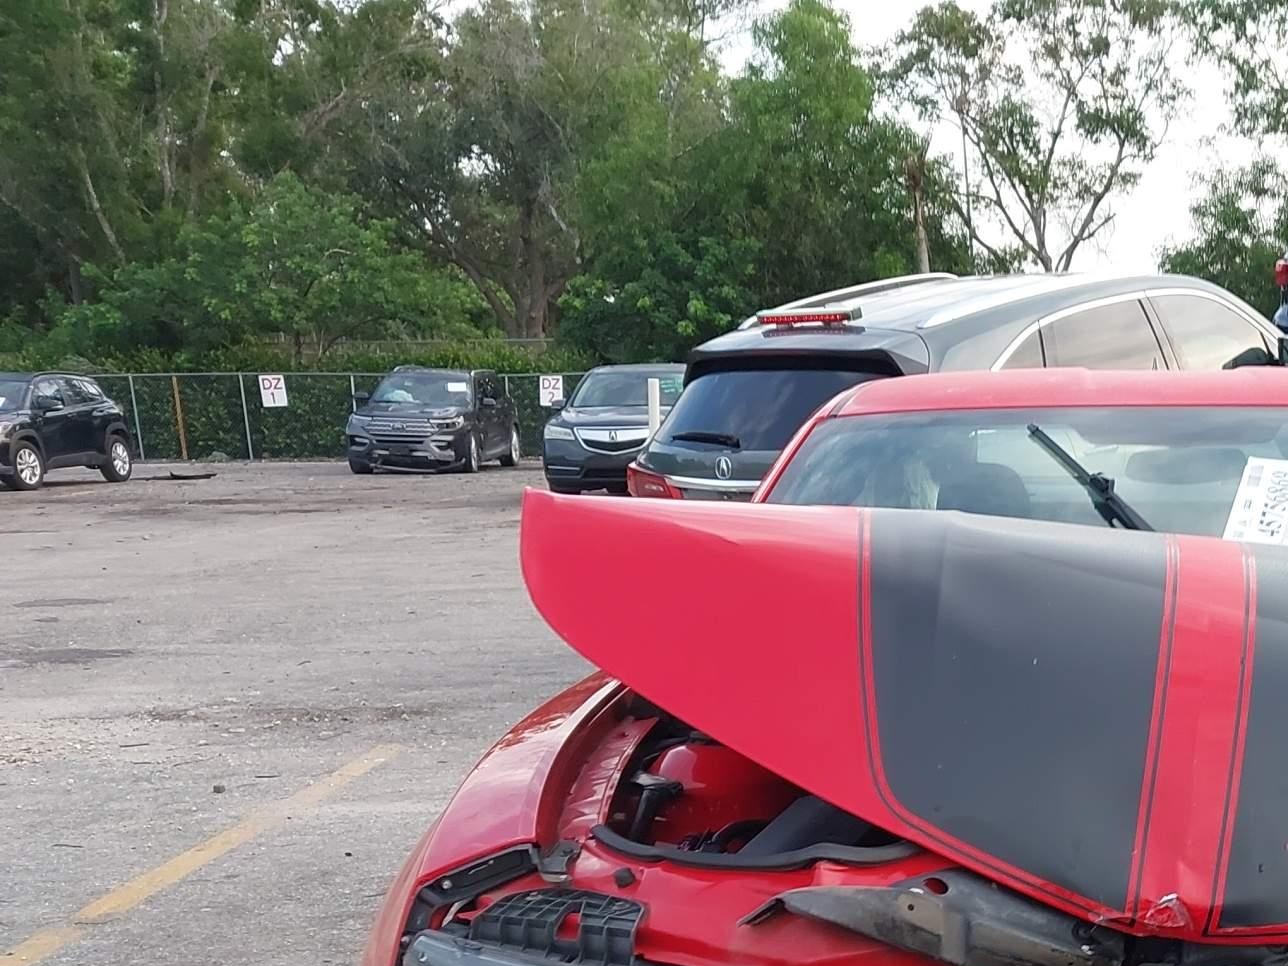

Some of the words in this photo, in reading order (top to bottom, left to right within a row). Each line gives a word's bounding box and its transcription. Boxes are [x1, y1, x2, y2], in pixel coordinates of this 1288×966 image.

[261, 377, 284, 390] DZ
[542, 377, 561, 390] DZ
[270, 391, 277, 405] 1
